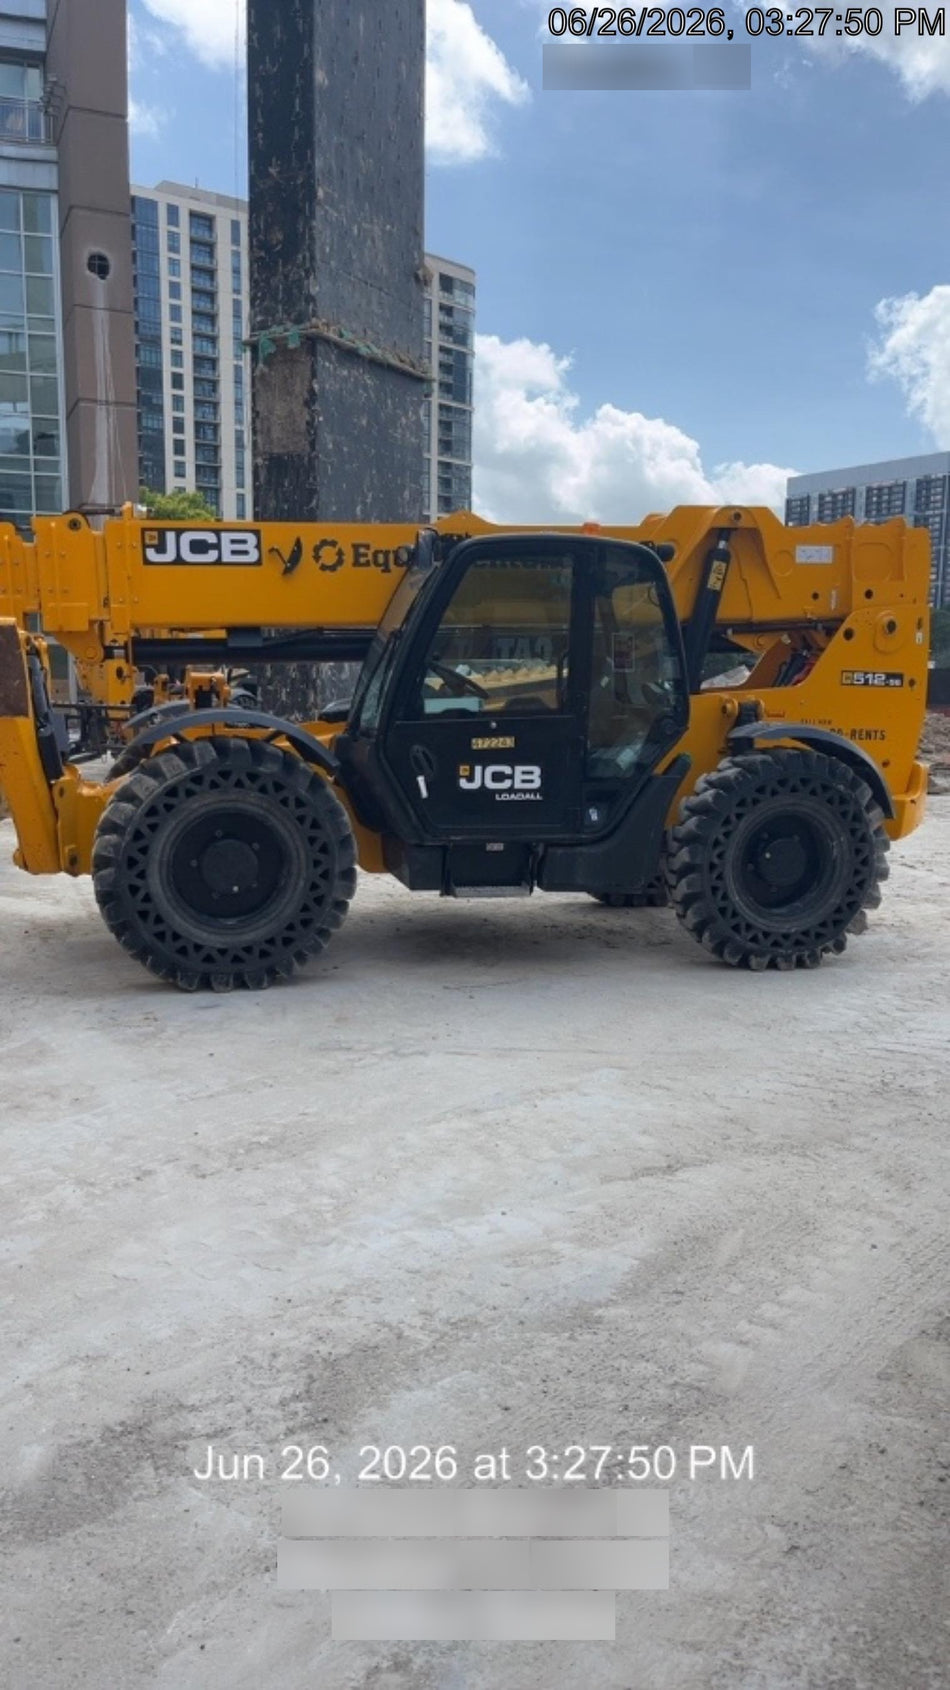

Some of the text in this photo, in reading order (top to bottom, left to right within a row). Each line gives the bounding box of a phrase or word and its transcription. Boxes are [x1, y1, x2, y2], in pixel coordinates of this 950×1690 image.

[144, 530, 260, 563] JCB
[459, 765, 542, 790] JCB
[495, 792, 543, 801] LOADALL
